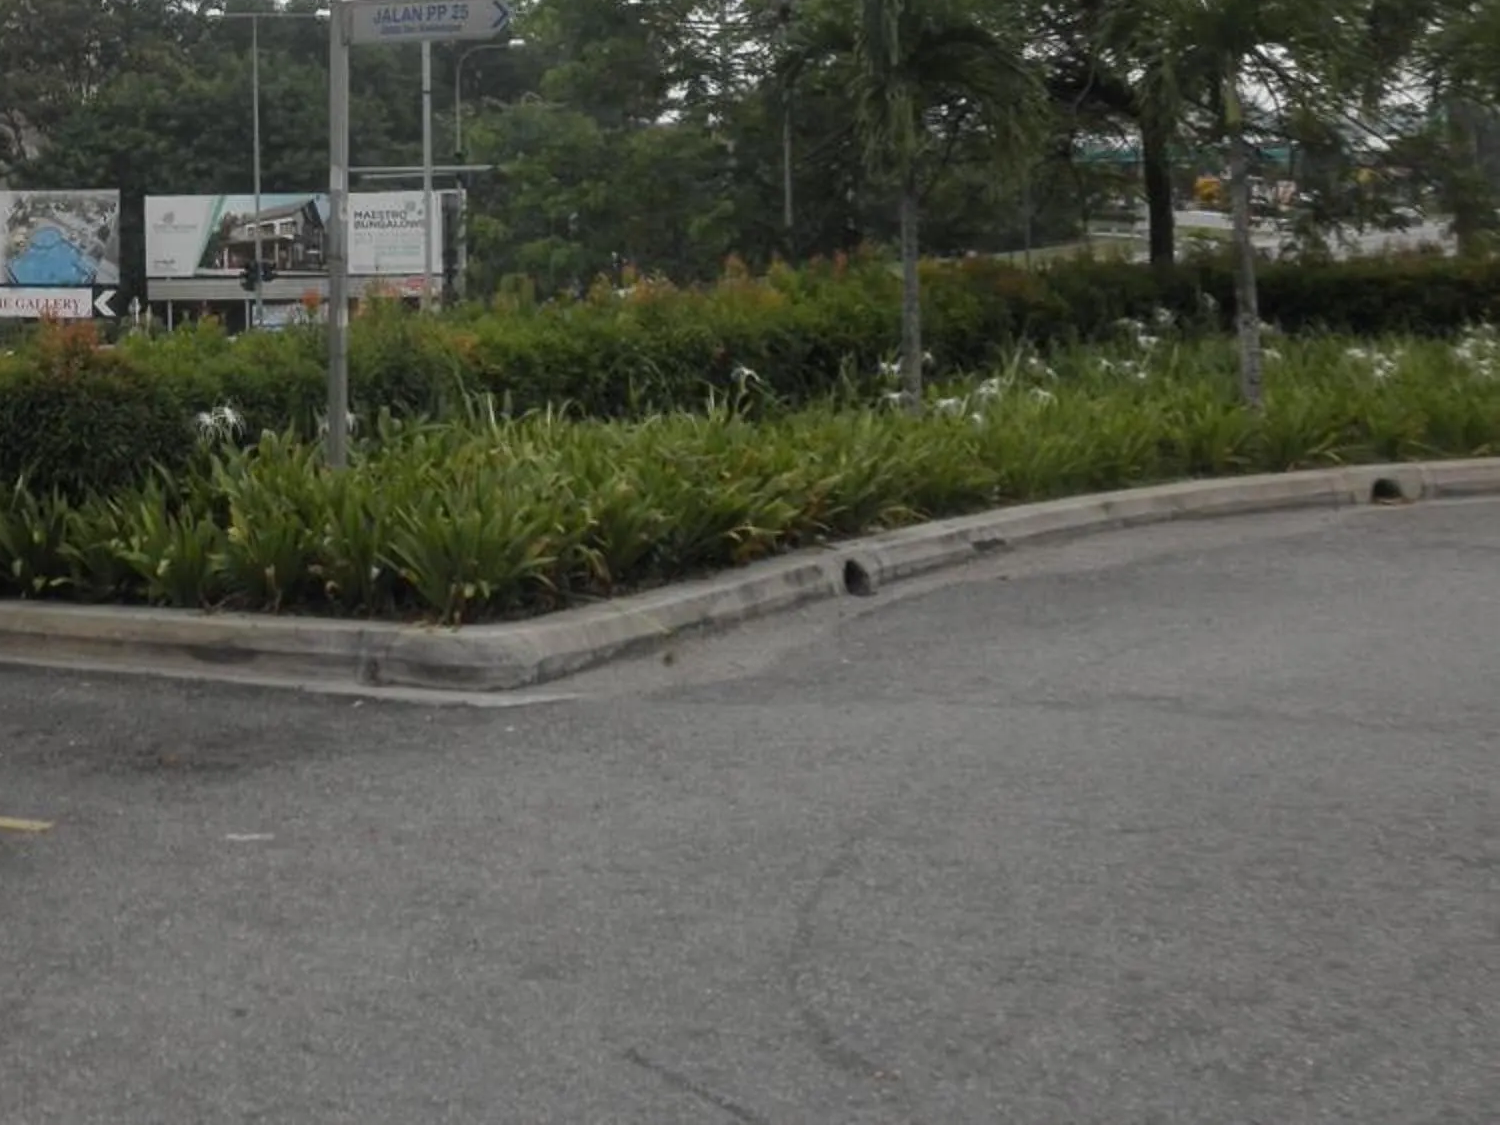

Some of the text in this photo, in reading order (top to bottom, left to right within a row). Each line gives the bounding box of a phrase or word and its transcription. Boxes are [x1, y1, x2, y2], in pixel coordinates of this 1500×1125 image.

[373, 5, 423, 24] JALAN
[426, 4, 447, 22] PP
[15, 296, 82, 312] GALLERY
